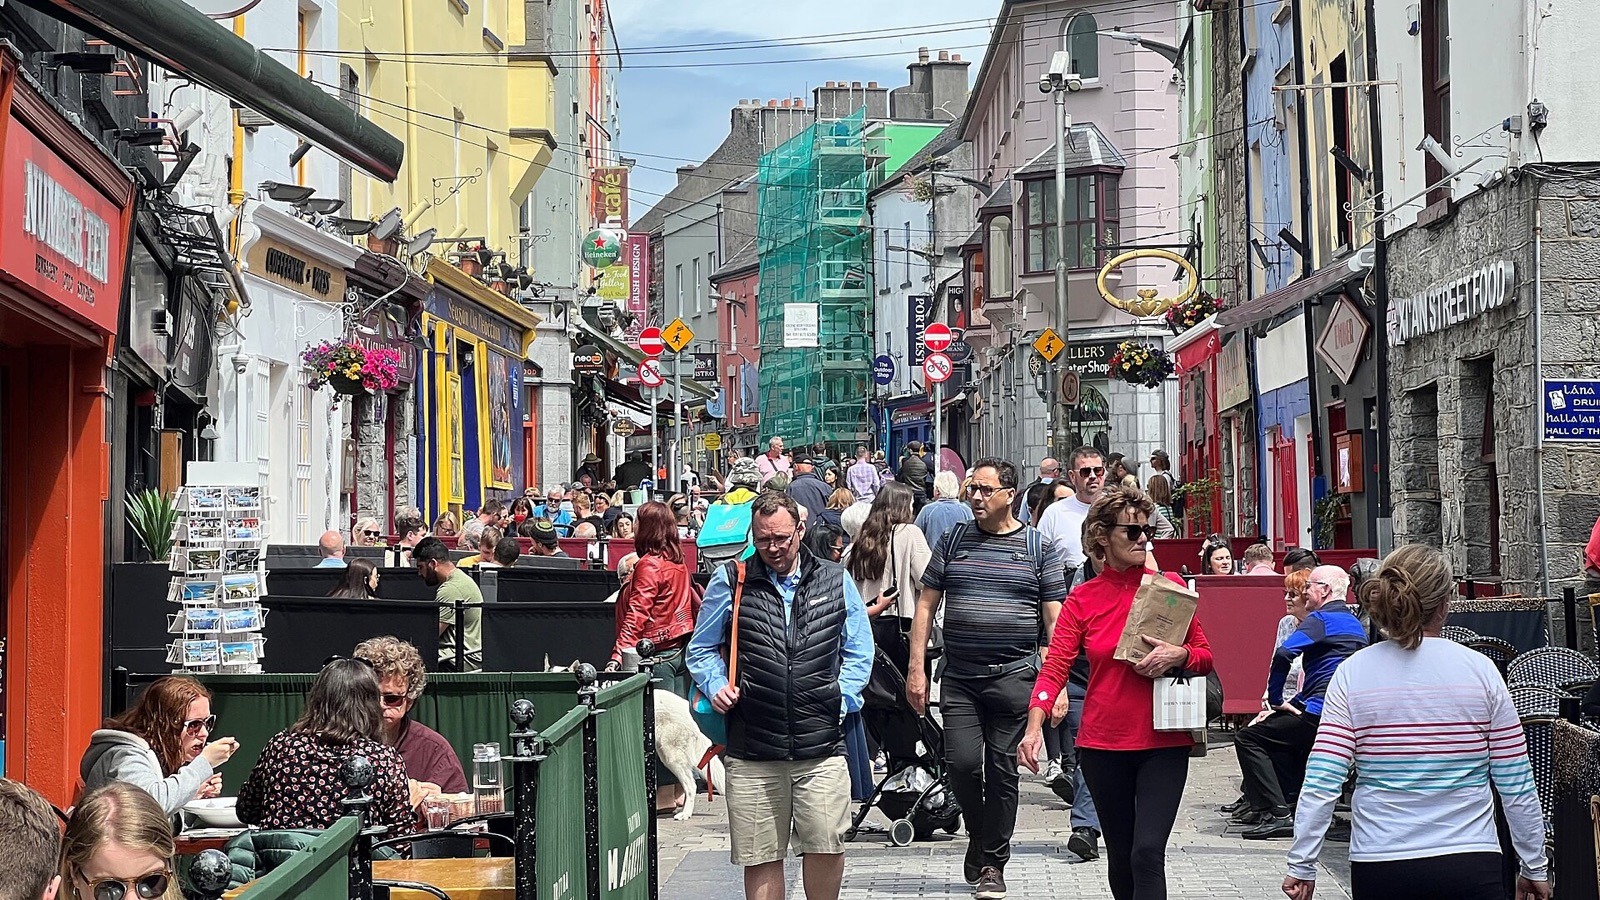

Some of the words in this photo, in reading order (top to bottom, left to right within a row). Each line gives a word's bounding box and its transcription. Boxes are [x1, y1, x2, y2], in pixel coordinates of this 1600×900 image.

[23, 159, 84, 268] NUMBER
[84, 206, 110, 284] TEN
[584, 251, 616, 259] Heineken
[632, 244, 641, 277] DESIGN
[612, 268, 628, 279] Food
[599, 278, 624, 289] Gallery
[632, 279, 641, 305] IRISH
[1399, 292, 1428, 341] XI'AN
[1429, 275, 1471, 332] STREET
[1472, 260, 1508, 315] FOOD
[1068, 345, 1105, 359] LLER'S
[1068, 363, 1088, 373] ater
[1088, 360, 1110, 375] Shop
[1546, 427, 1570, 435] HALL
[1571, 427, 1585, 435] OF
